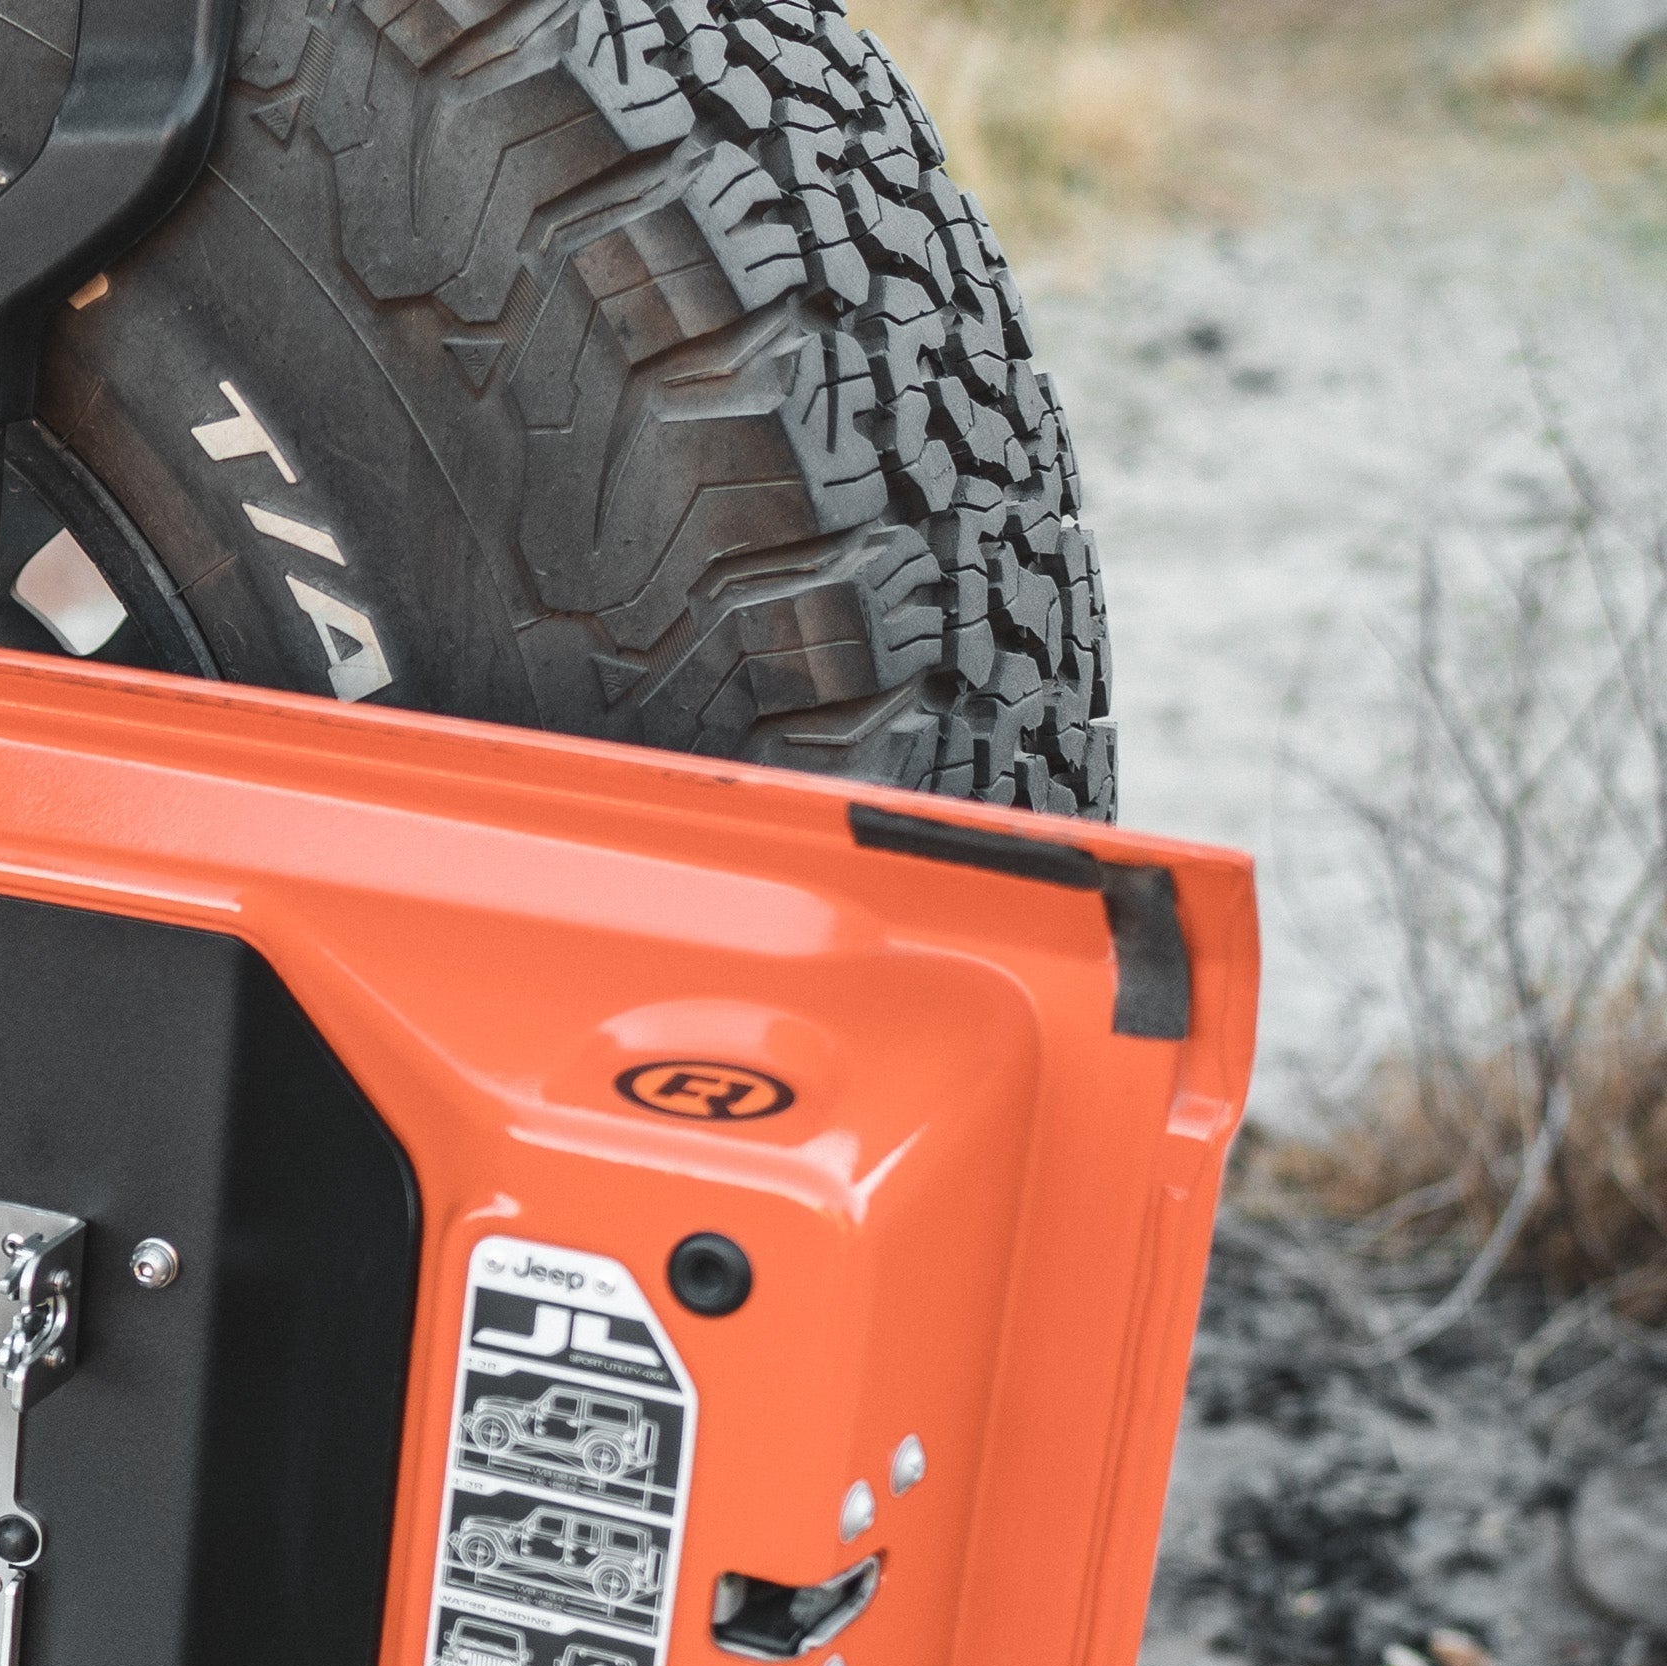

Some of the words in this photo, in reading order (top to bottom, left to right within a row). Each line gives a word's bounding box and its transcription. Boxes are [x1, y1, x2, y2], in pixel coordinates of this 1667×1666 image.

[513, 1256, 586, 1292] Jeep
[472, 1303, 664, 1368] JL
[568, 1353, 602, 1369] SPORT
[603, 1361, 640, 1377] UTILITY
[440, 1594, 486, 1611] WATER
[489, 1606, 551, 1627] FORDING
